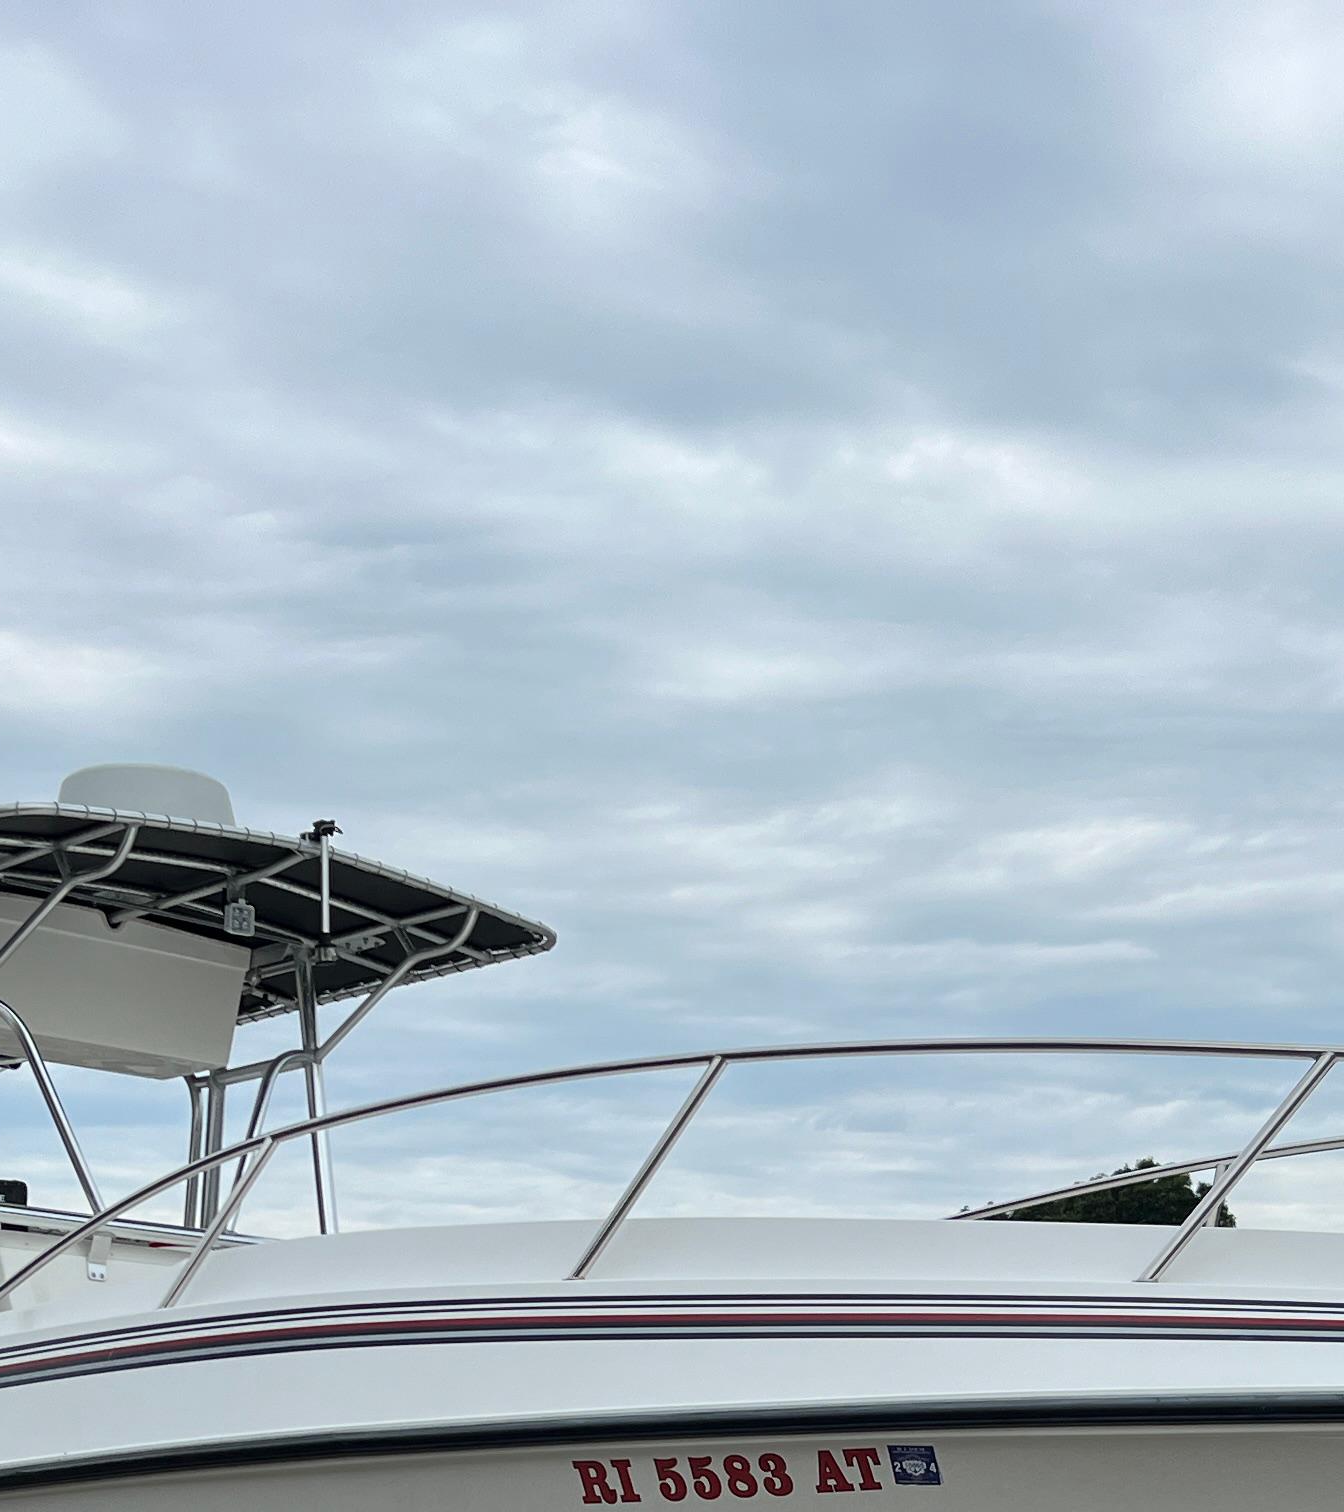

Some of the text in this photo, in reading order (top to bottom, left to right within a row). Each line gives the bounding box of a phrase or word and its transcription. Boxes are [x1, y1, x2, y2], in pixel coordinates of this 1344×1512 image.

[572, 1447, 883, 1504] RI 5583 AT
